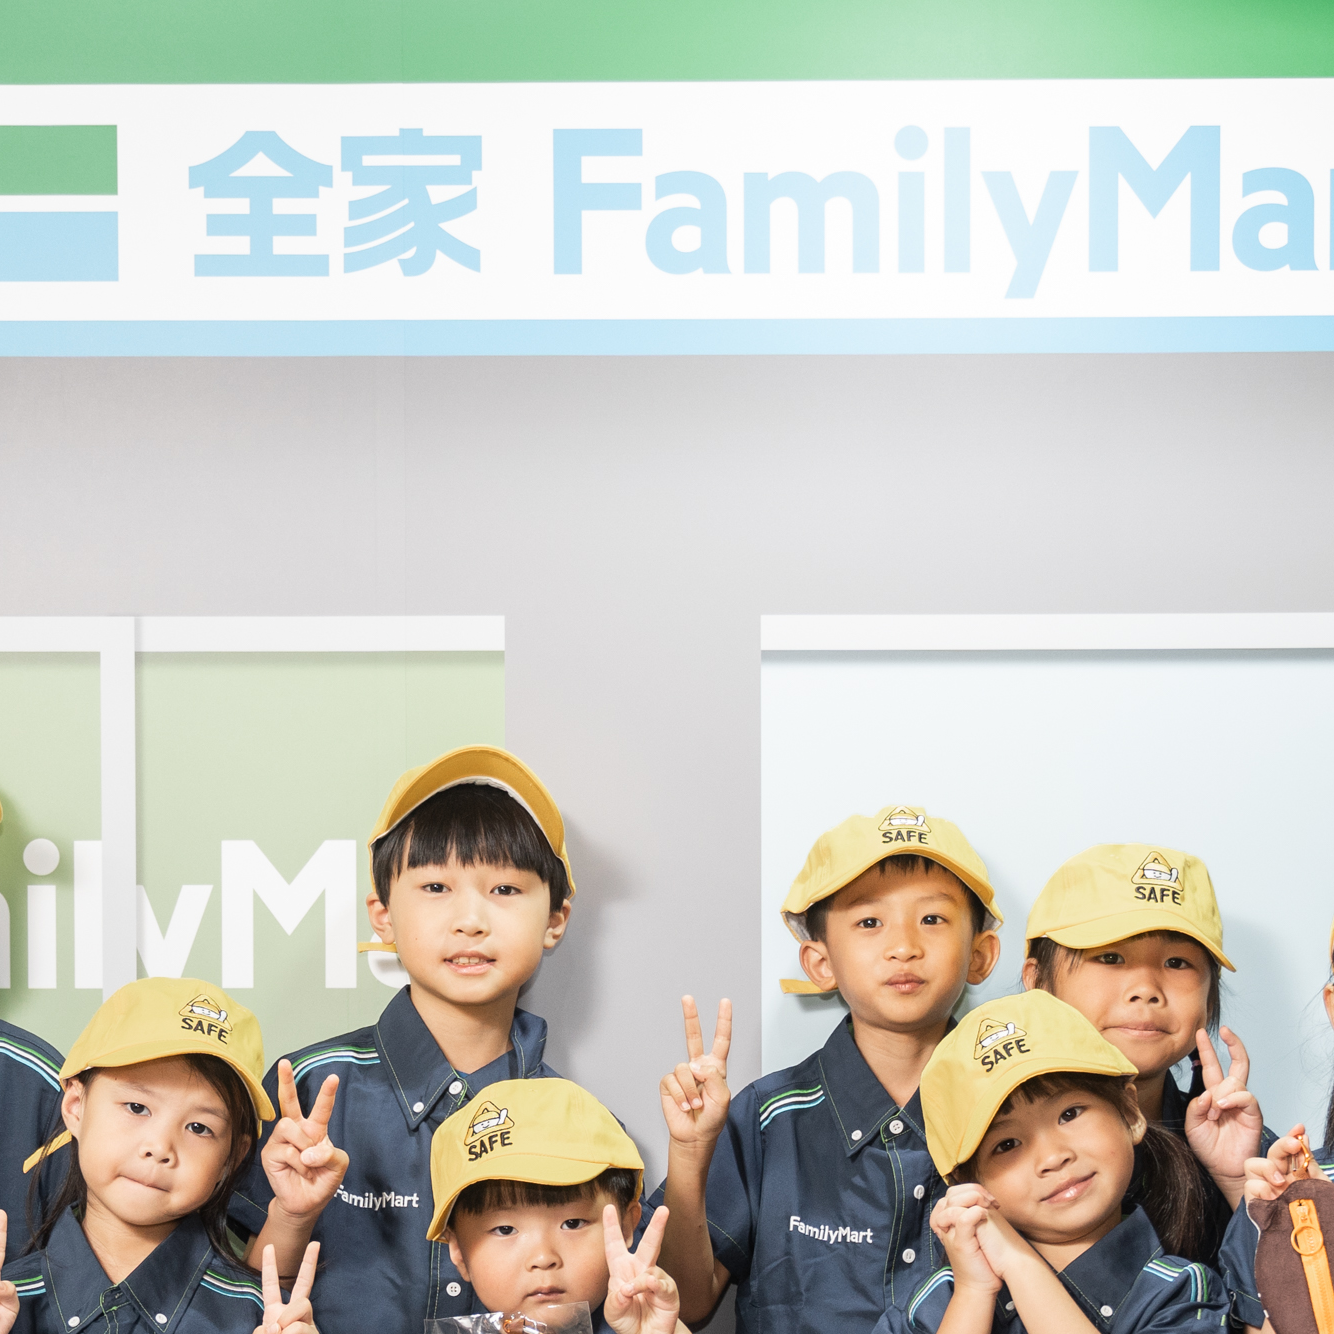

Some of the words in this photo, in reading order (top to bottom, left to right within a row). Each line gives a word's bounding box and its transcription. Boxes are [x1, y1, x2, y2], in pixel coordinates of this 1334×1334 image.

[187, 127, 484, 278] 全家
[881, 829, 930, 845] SAFE
[1134, 885, 1182, 906] SAFE
[181, 1017, 229, 1045] SAFE
[981, 1038, 1031, 1073] SAFE
[468, 1130, 513, 1162] SAFE
[789, 1215, 874, 1245] FamilyMart
